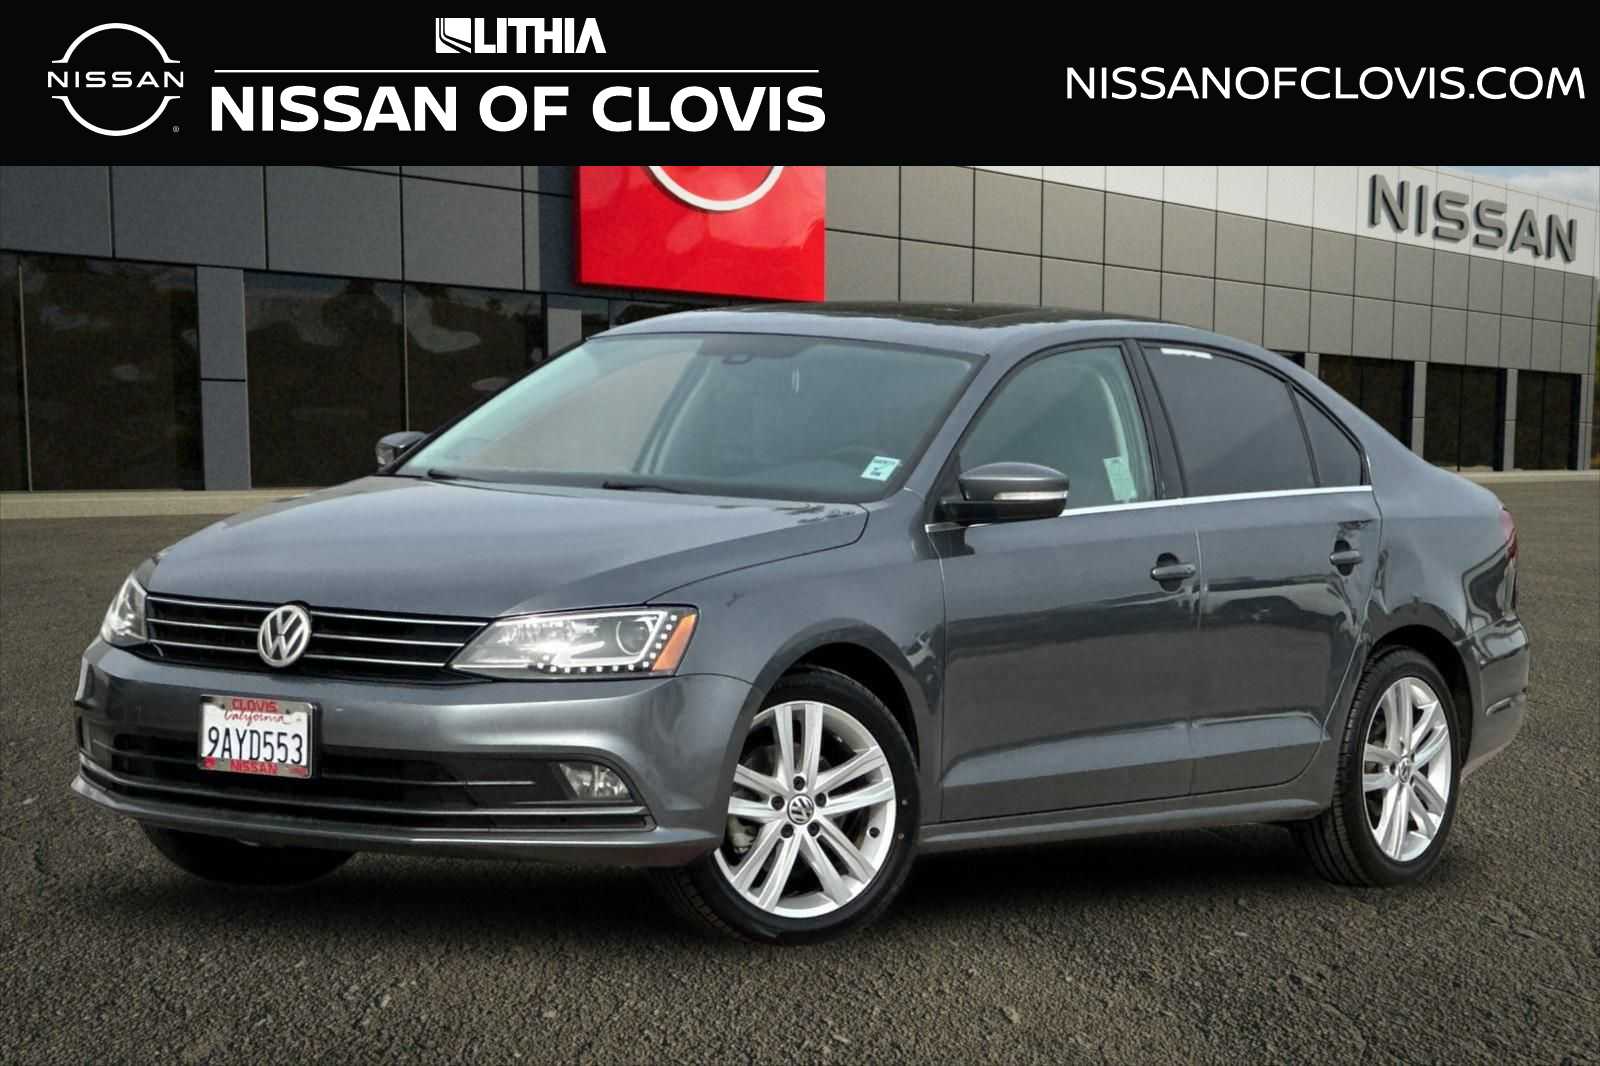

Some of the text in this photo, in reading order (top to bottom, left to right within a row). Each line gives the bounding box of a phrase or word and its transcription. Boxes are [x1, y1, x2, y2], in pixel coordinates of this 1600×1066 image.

[1368, 174, 1578, 263] NISSAN
[231, 697, 279, 713] CLOVIS
[207, 725, 304, 765] 9AYD553
[229, 760, 278, 774] NISSAN
